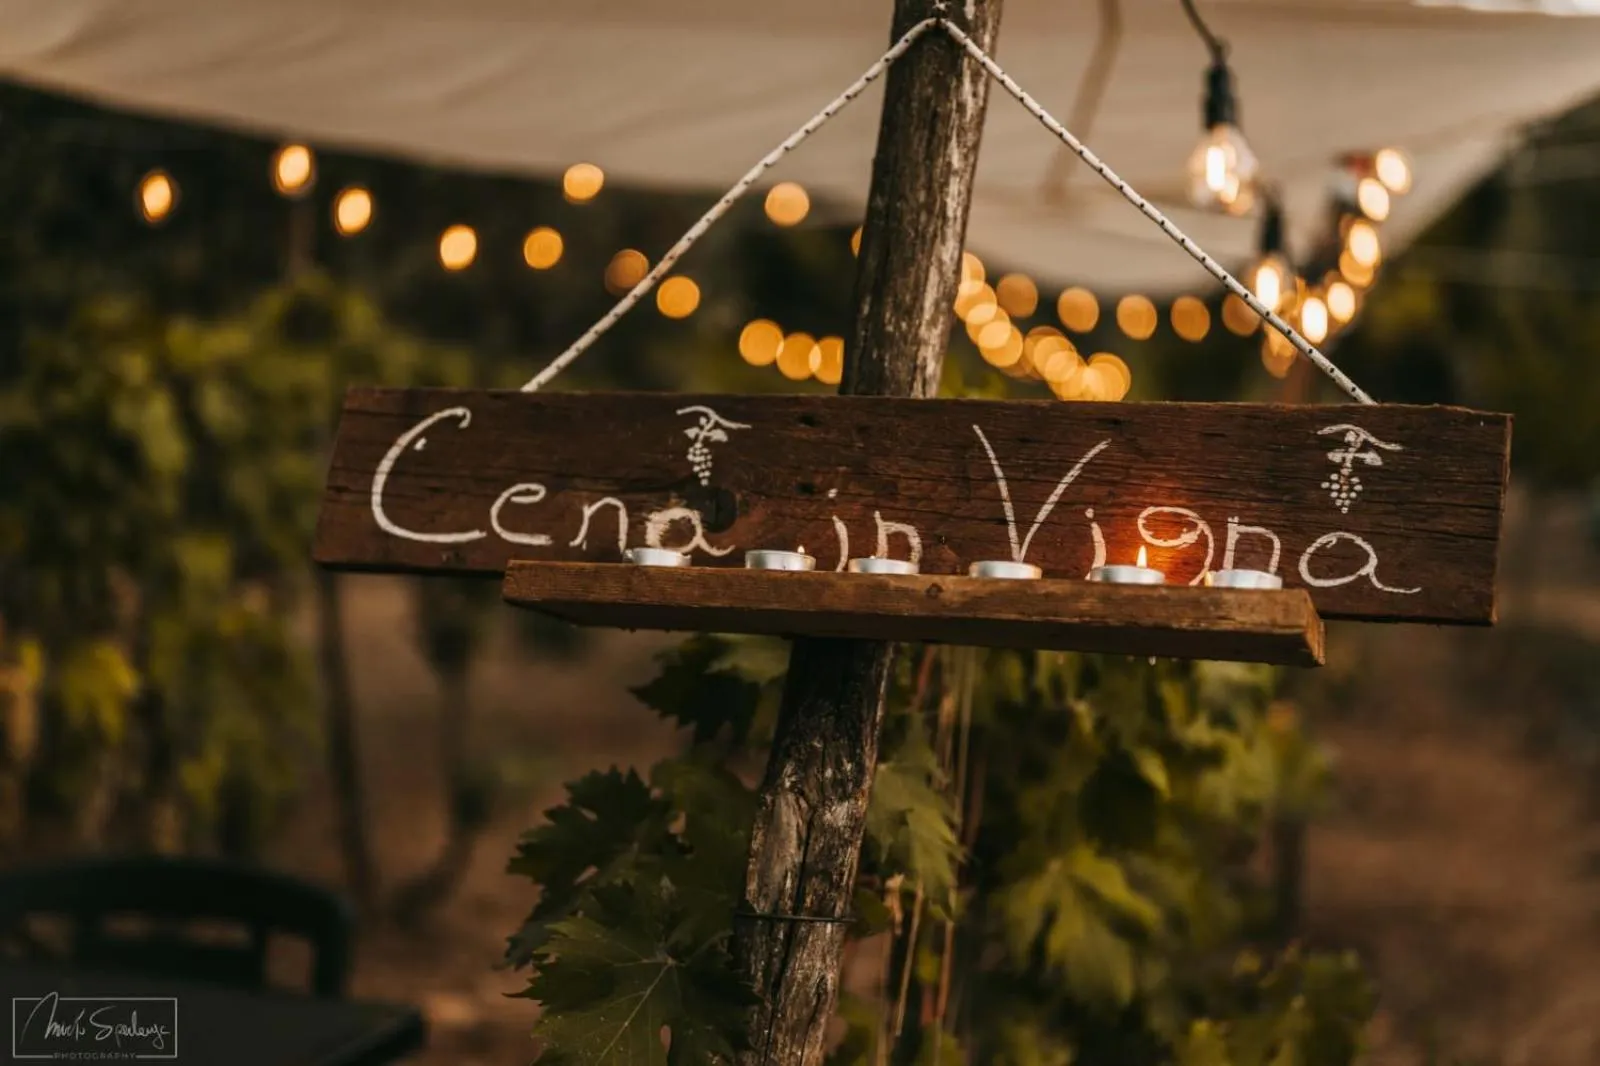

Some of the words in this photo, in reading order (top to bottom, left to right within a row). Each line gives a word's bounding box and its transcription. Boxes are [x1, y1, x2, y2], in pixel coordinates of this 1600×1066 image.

[371, 407, 736, 557] Cena
[828, 488, 923, 573] in
[971, 424, 1422, 594] Vigna
